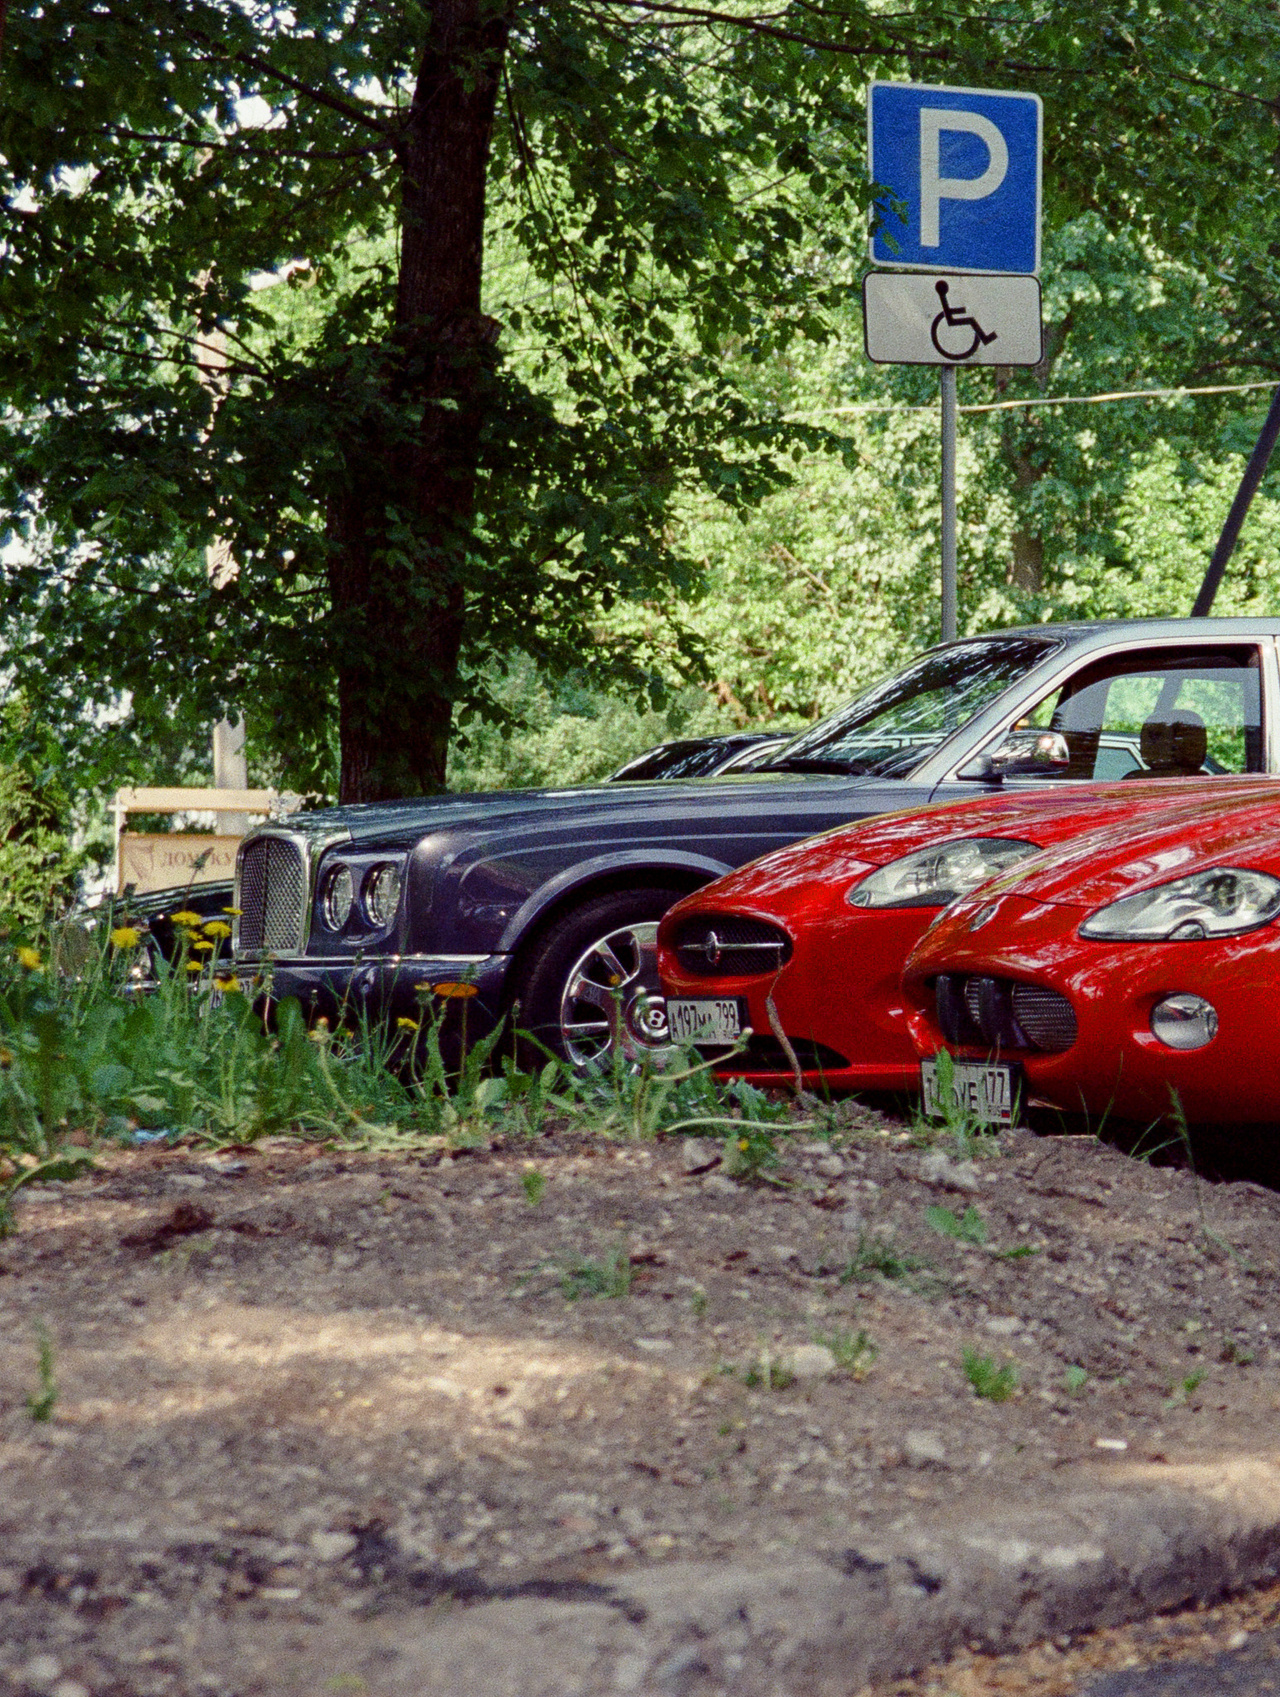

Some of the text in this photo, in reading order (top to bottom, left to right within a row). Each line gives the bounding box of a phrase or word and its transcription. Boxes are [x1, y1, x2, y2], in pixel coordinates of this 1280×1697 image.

[920, 108, 1009, 247] P
[715, 1002, 736, 1029] 799
[981, 1071, 1005, 1103] 177
